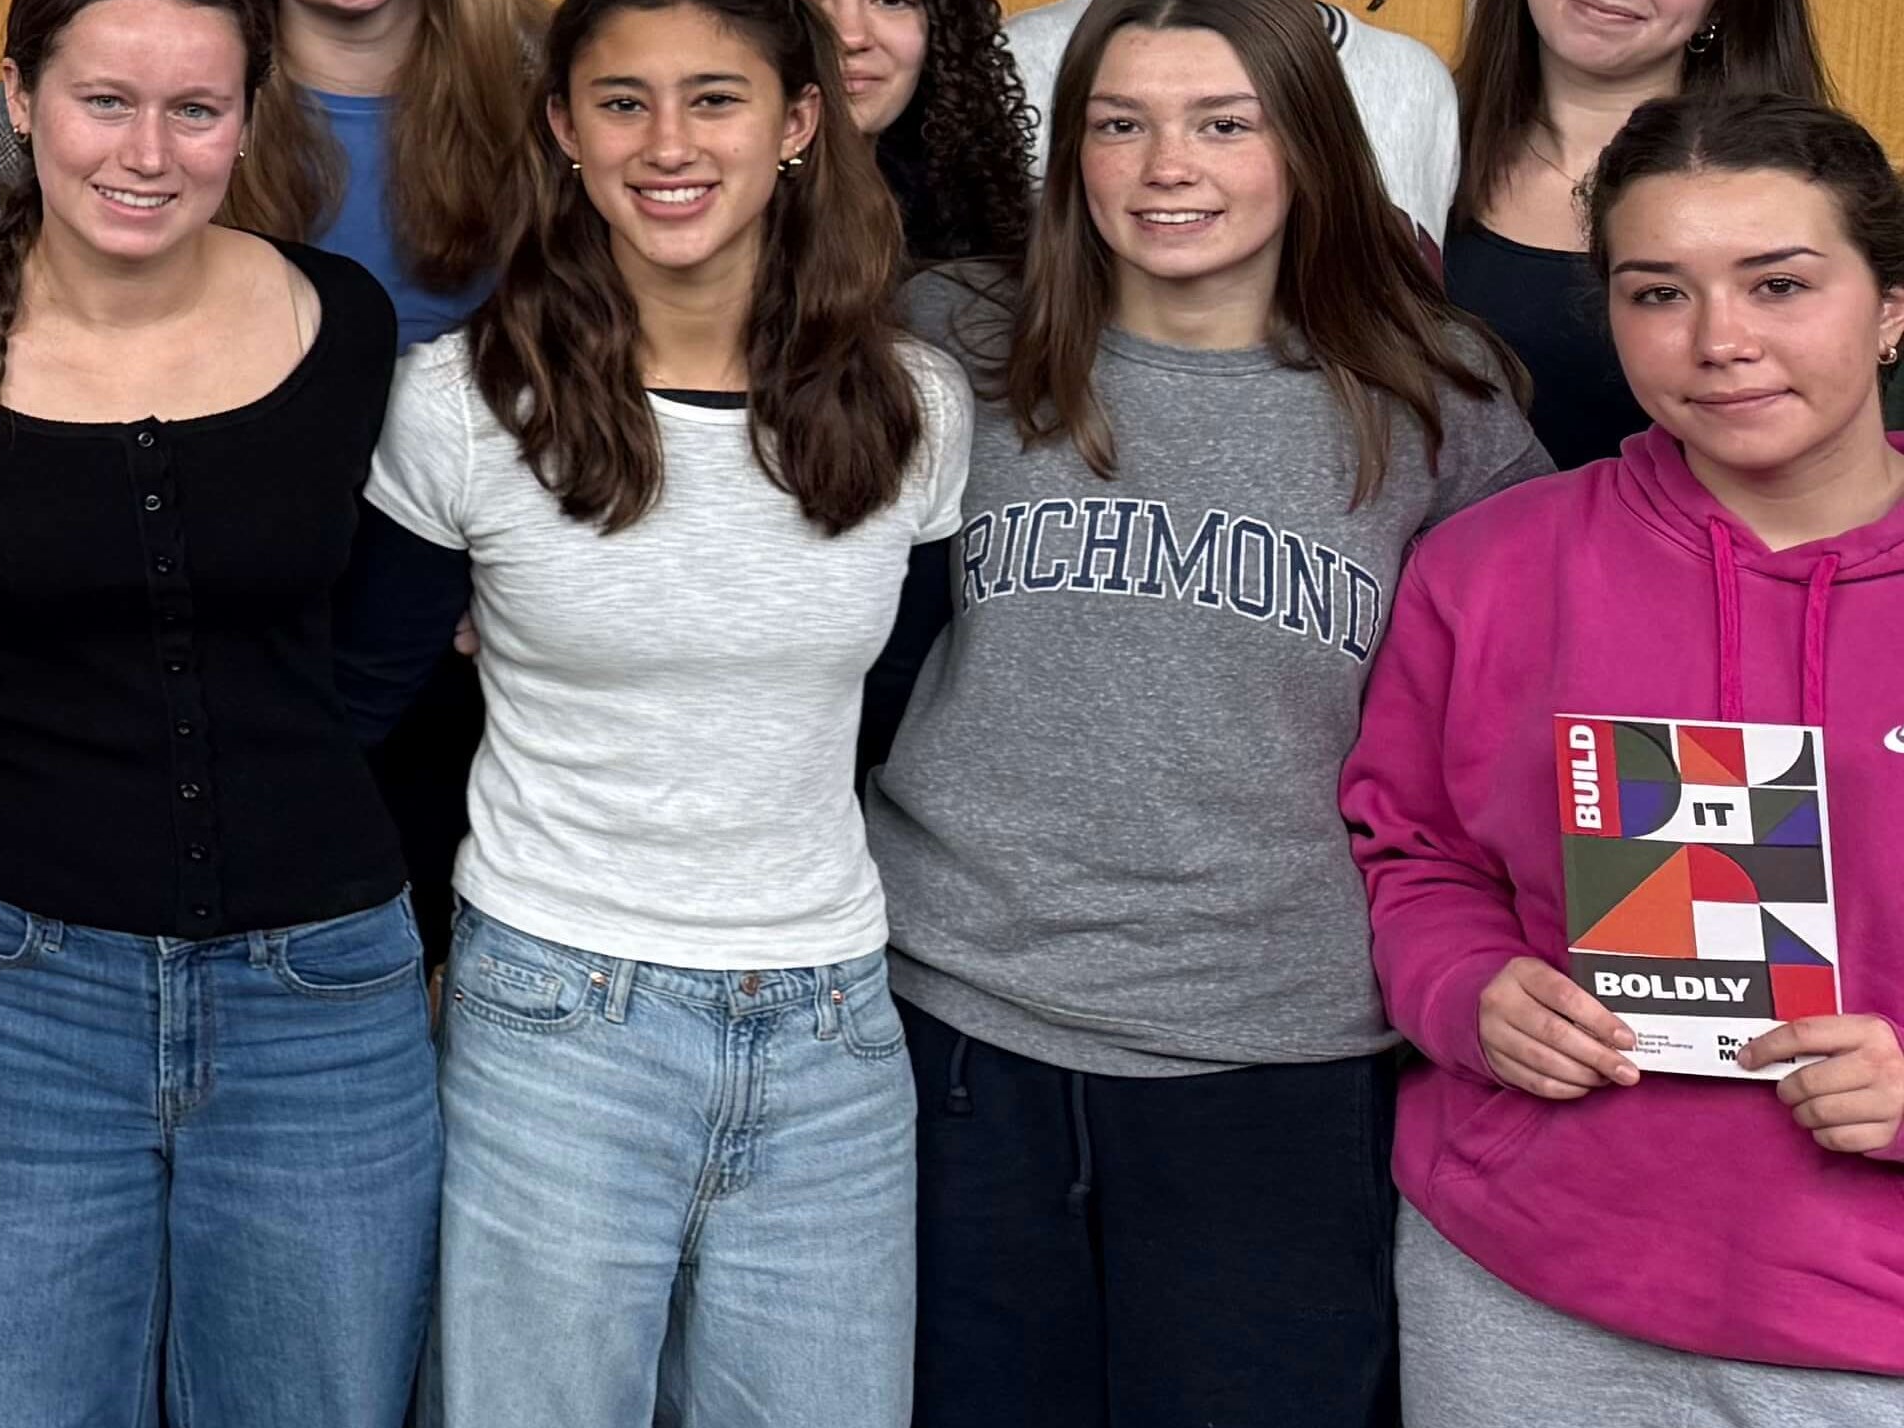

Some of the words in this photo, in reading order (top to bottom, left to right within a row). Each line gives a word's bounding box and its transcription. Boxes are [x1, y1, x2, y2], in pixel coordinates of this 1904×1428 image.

[961, 497, 1382, 665] RICHMOND
[1569, 725, 1602, 829] BUILD
[1692, 802, 1734, 826] IT
[1594, 972, 1751, 1002] BOLDLY
[1717, 1035, 1741, 1046] Dr.
